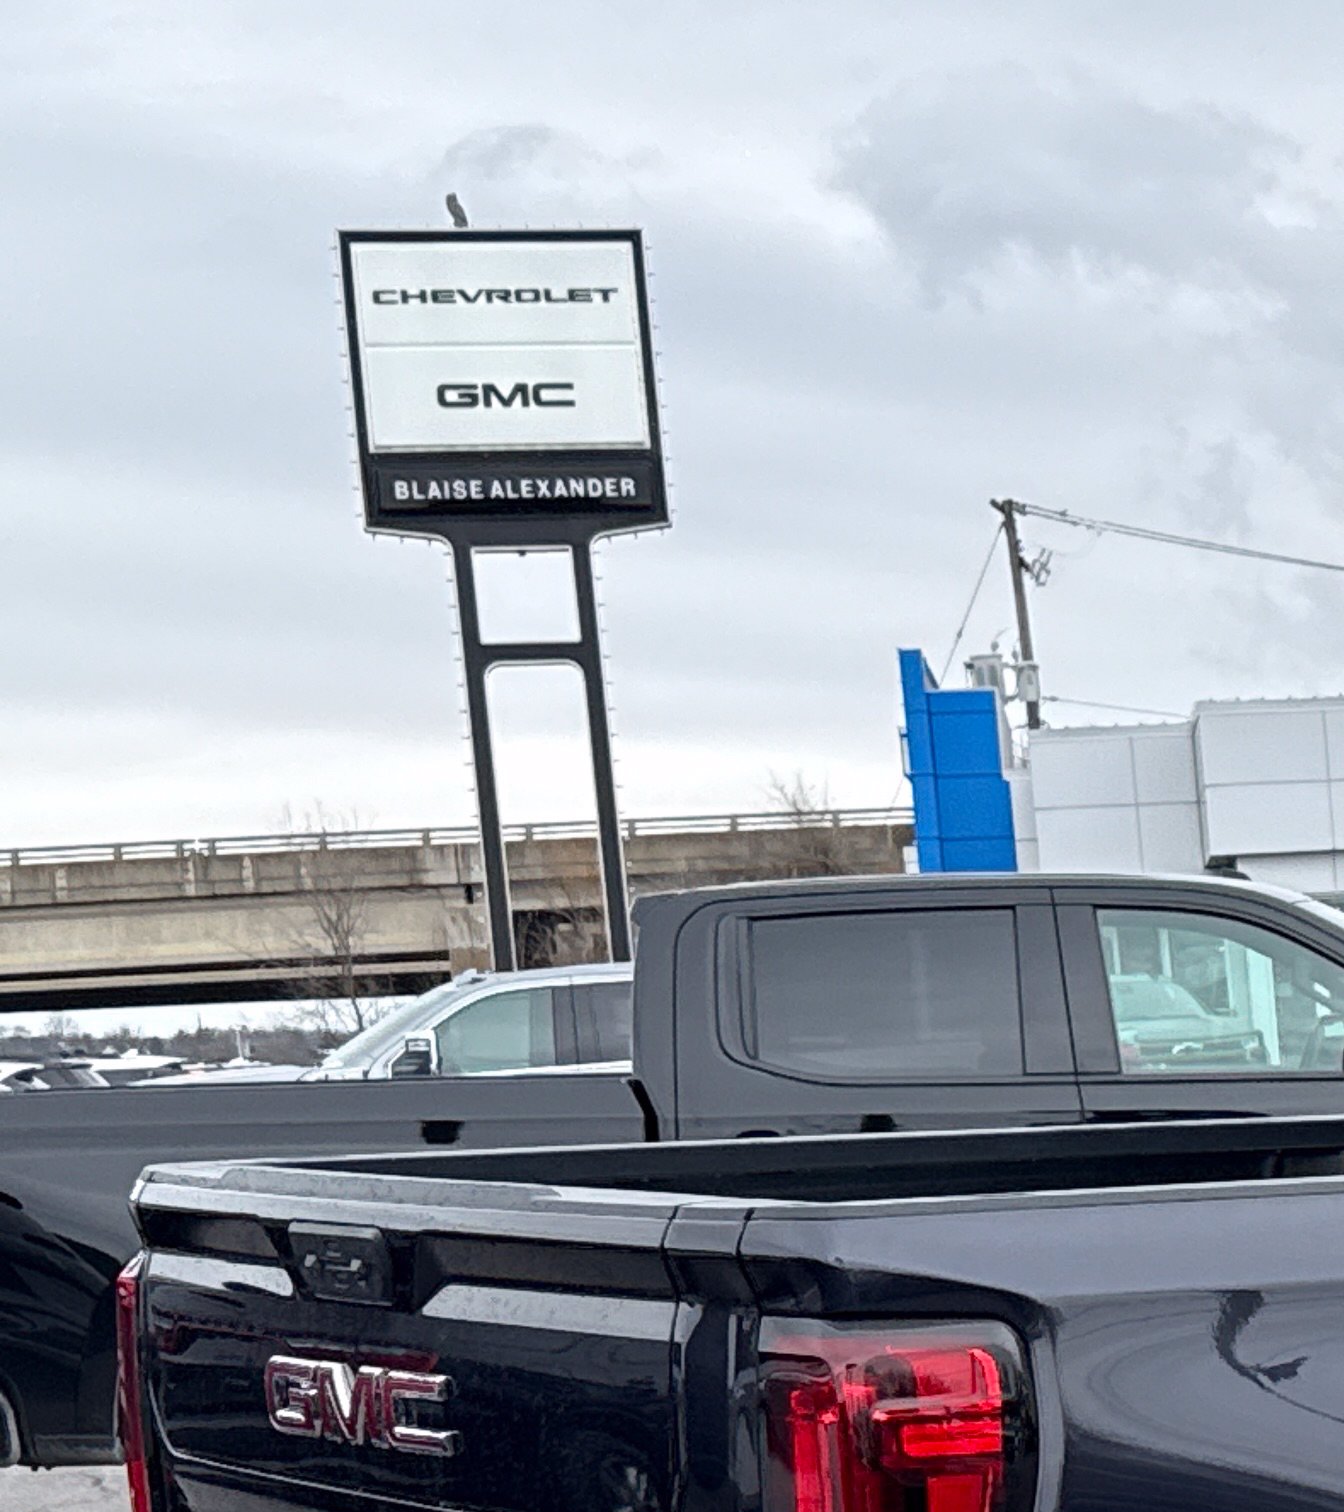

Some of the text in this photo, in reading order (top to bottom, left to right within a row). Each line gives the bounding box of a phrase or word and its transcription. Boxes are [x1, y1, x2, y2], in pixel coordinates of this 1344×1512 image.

[372, 287, 618, 305] CHEVROLET
[436, 382, 576, 408] GMC
[394, 477, 636, 500] BLAISE ALEXANDER
[264, 1355, 464, 1457] GMC
